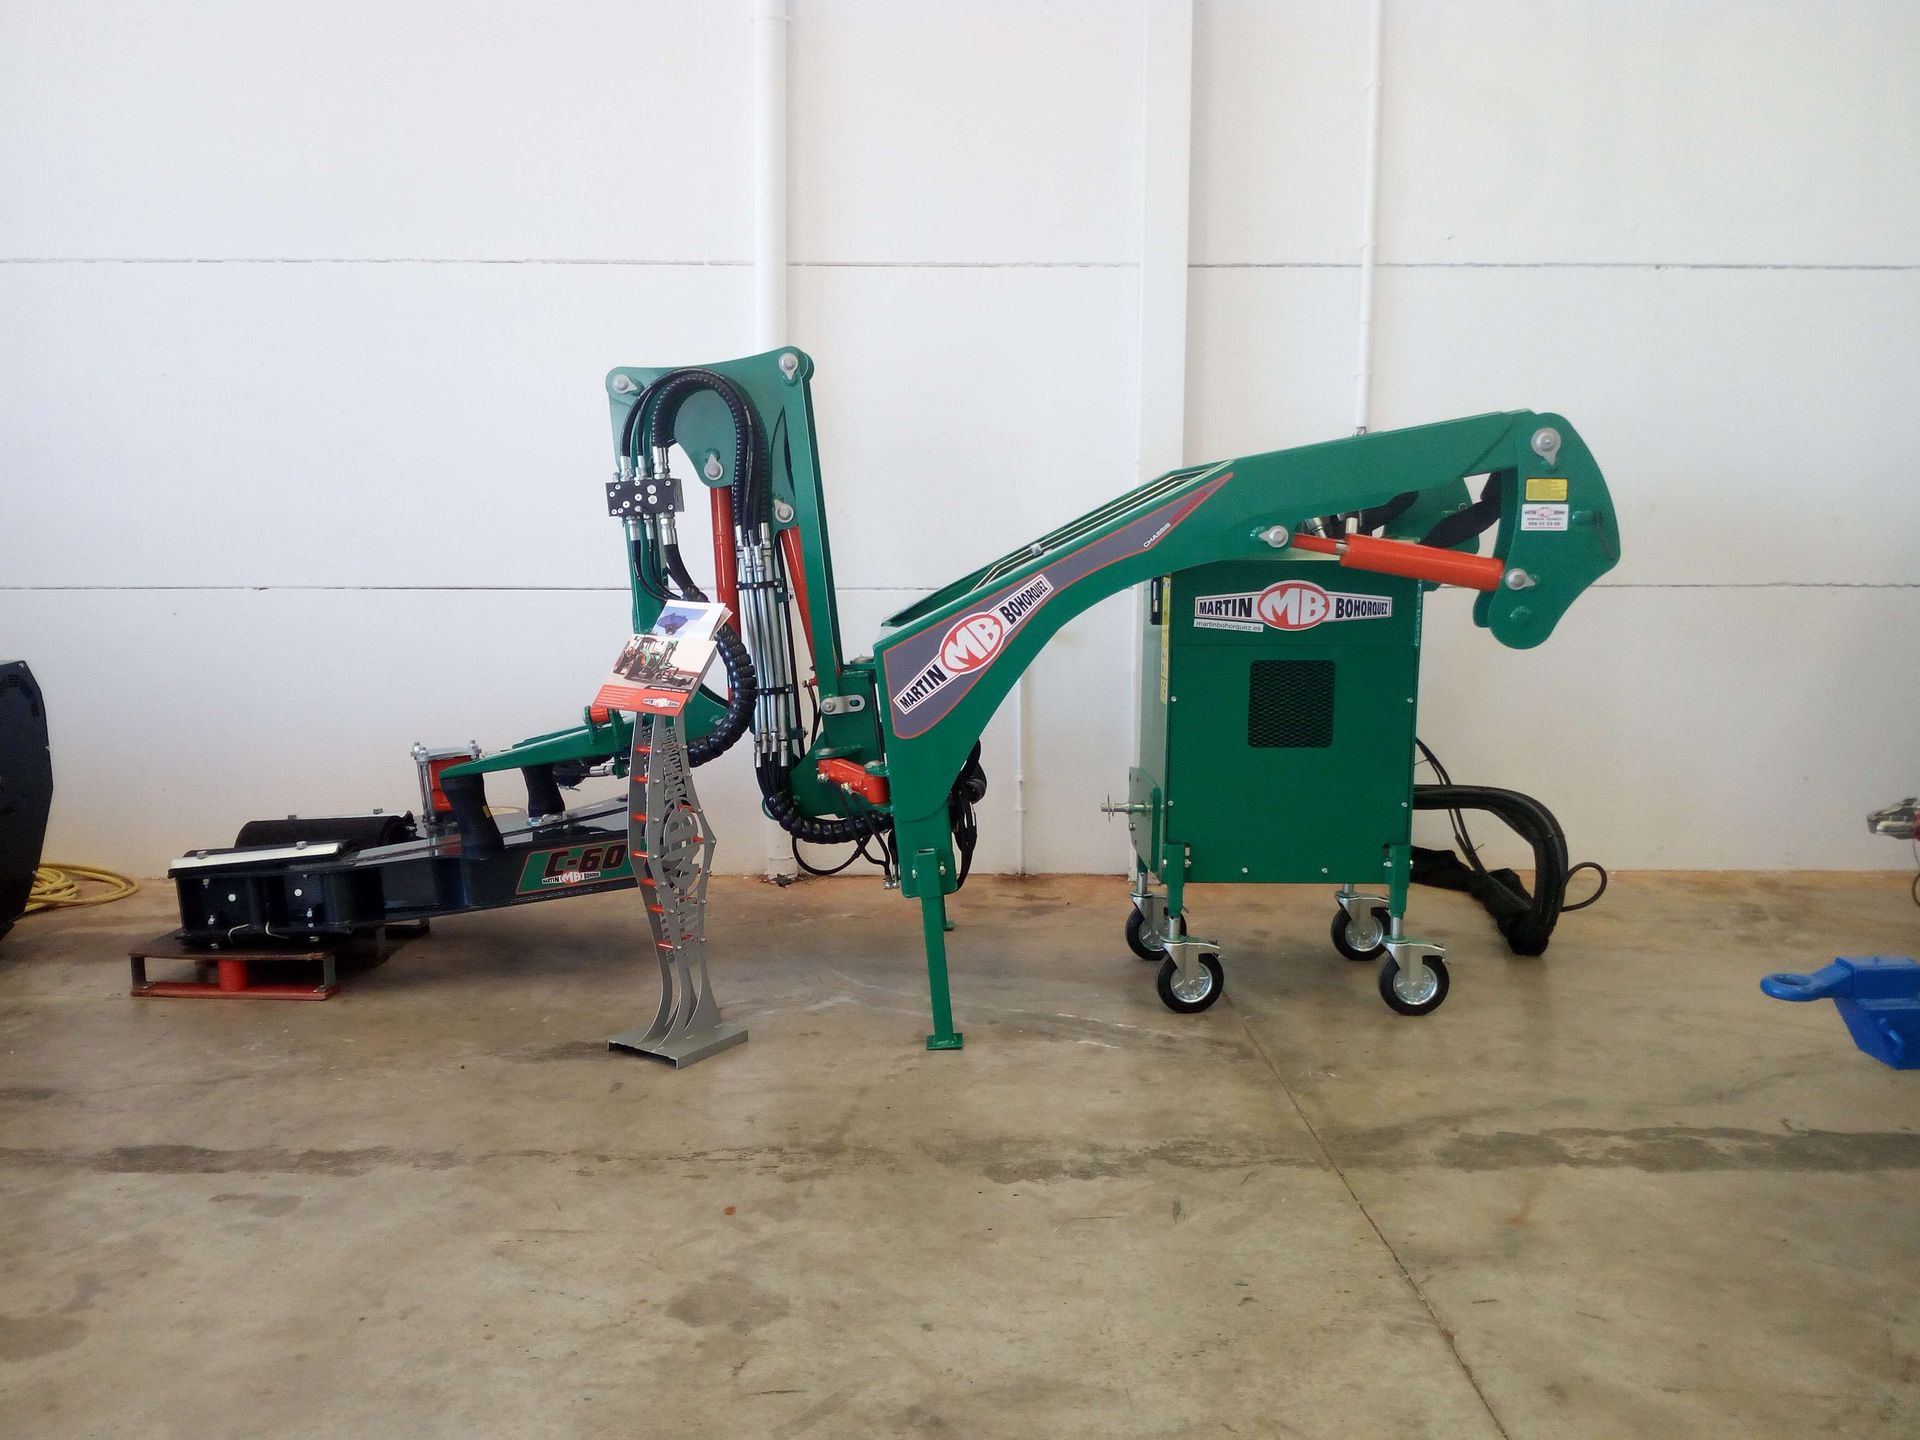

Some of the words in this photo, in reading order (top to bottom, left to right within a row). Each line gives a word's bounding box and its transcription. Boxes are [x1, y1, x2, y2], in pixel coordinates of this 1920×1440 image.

[1198, 597, 1253, 618] MARTIN
[1261, 587, 1328, 625] MB
[1335, 597, 1389, 618] BOHORQUEZ
[899, 664, 948, 709] MARTIN
[944, 617, 1001, 671] MB
[999, 579, 1049, 626] BOHORQUEZ
[1196, 620, 1262, 632] martinbohorquez.es
[543, 844, 628, 878] C-60
